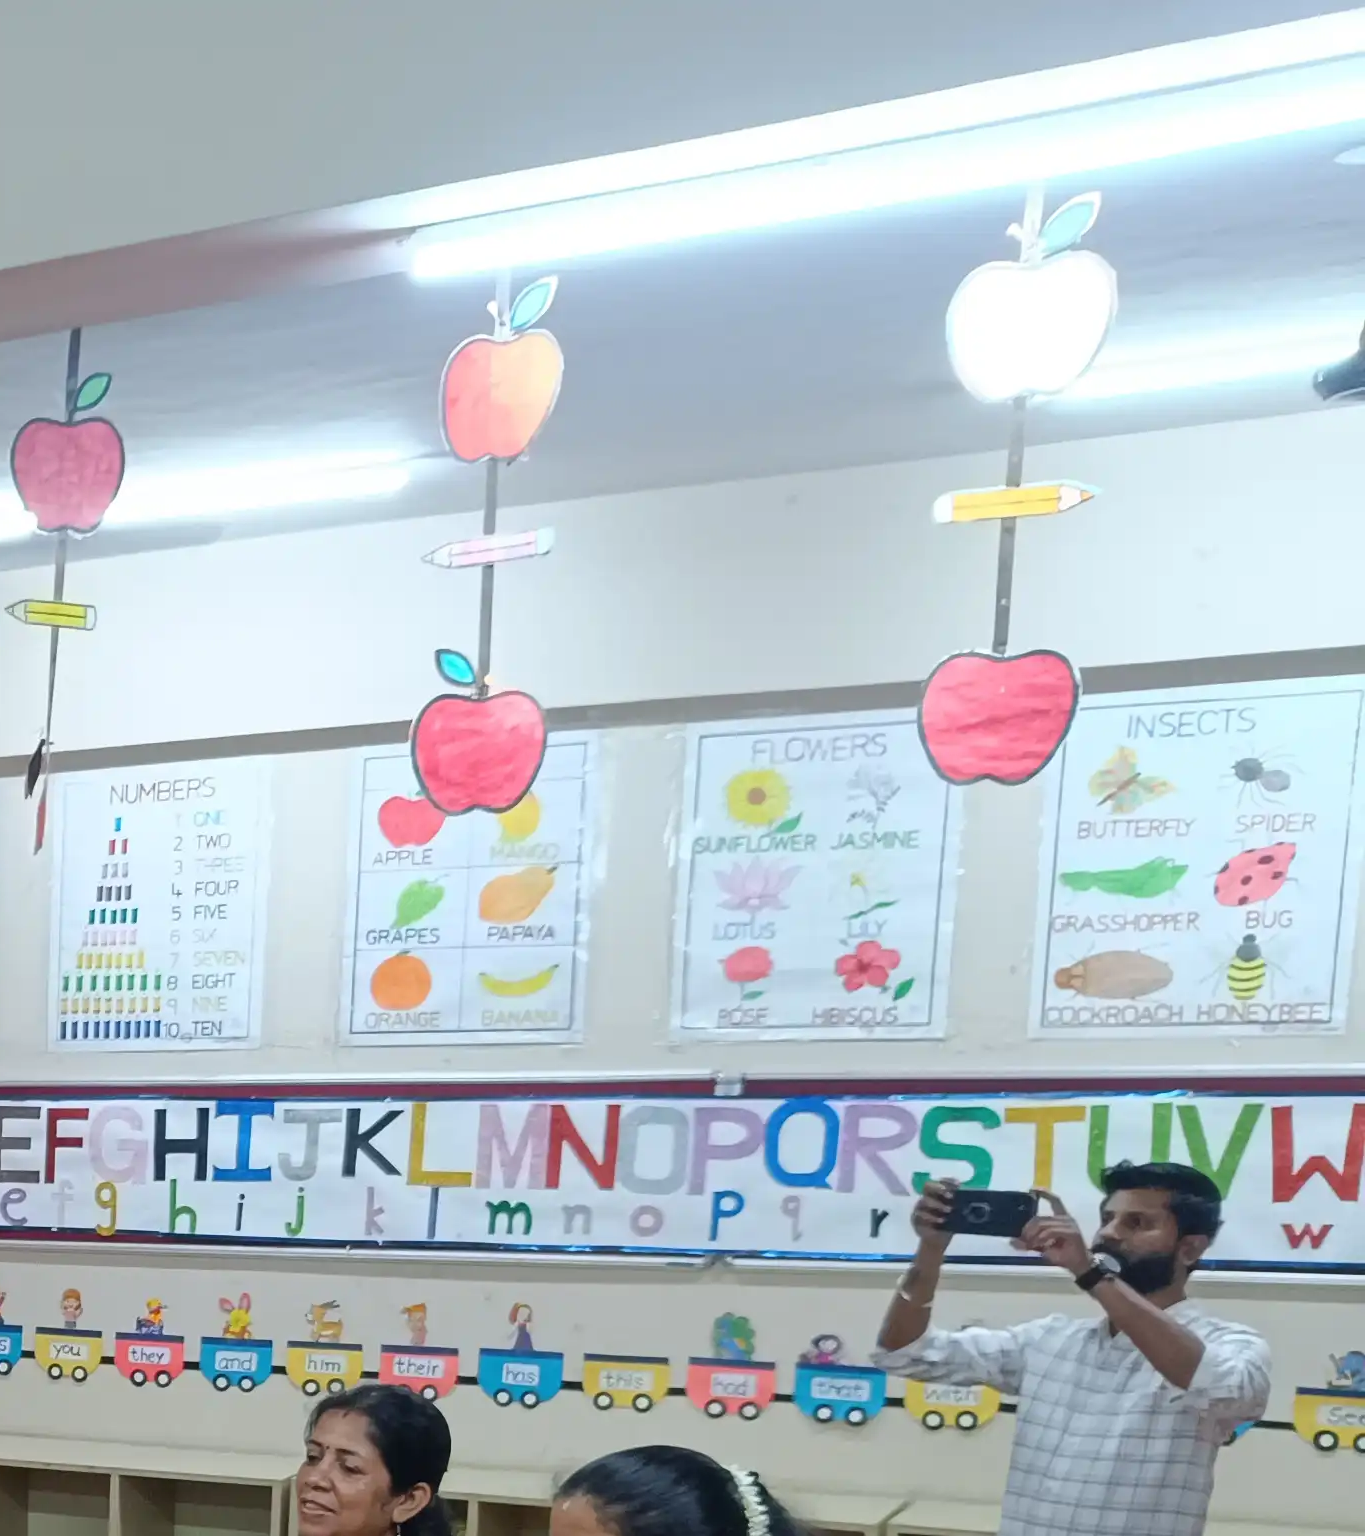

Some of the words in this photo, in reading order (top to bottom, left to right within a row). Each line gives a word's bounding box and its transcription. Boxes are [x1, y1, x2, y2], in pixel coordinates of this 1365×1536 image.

[1127, 707, 1257, 739] INSECTS
[751, 733, 888, 765] FLOWERS
[109, 777, 216, 805] NUMBERS
[1077, 817, 1197, 840] BUTTERFLY
[1235, 812, 1317, 834] SPIDER
[173, 836, 184, 852] 2
[196, 833, 232, 850] TWO
[694, 832, 817, 855] SUNFLOWER
[830, 830, 920, 851] JASMINE
[173, 859, 184, 875] 3
[372, 848, 433, 867] APPLE
[171, 882, 183, 899] 4
[194, 879, 239, 898] FOUR
[171, 905, 182, 921] 5
[193, 904, 228, 921] FIVE
[1052, 911, 1200, 933] GRASSHOPPER
[1245, 909, 1294, 930] BUG
[192, 927, 217, 944] SIX
[365, 927, 440, 946] GRAPES
[486, 923, 557, 943] PAPAYA
[712, 920, 776, 941] LOTUS
[846, 919, 888, 940] LILY
[192, 950, 246, 968] SEVEN
[166, 975, 178, 991] 8
[191, 973, 236, 990] EIGHT
[166, 998, 178, 1015] 9
[718, 1006, 769, 1026] ROSE
[1044, 1003, 1183, 1025] COCKROACH
[1196, 1002, 1325, 1024] HONEYBEE
[162, 1022, 180, 1038] 10
[192, 1020, 223, 1037] TEN
[364, 1011, 440, 1029] ORANGE
[0, 1187, 28, 1226] e
[95, 1181, 117, 1236] g
[169, 1178, 197, 1234] h
[285, 1186, 306, 1237] j
[364, 1186, 386, 1236] k
[485, 1199, 532, 1236] m
[708, 1190, 744, 1242] p
[780, 1195, 803, 1242] q
[869, 1208, 890, 1238] r
[1281, 1223, 1335, 1249] w
[52, 1343, 83, 1358] you
[130, 1346, 166, 1365] they
[218, 1355, 254, 1371] and
[307, 1355, 342, 1373] him
[395, 1357, 440, 1375] their
[504, 1365, 537, 1384] has
[603, 1372, 645, 1390] this
